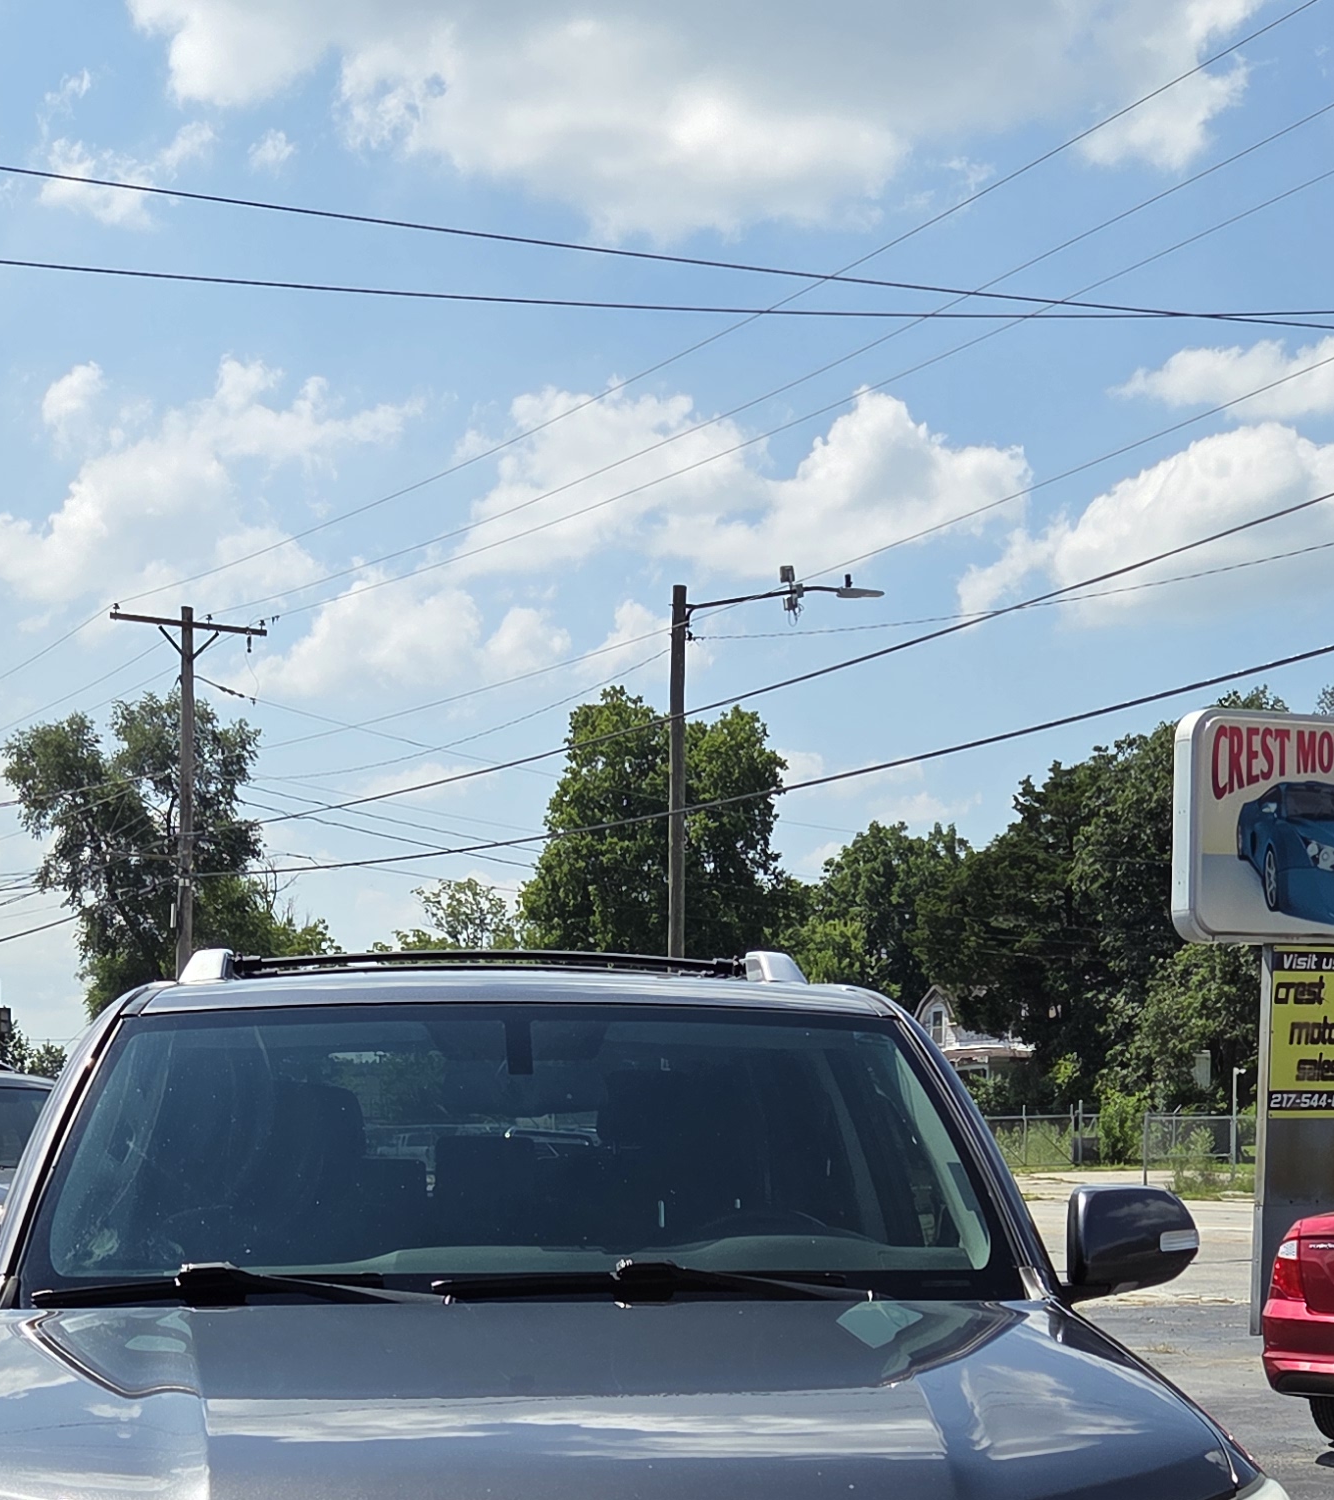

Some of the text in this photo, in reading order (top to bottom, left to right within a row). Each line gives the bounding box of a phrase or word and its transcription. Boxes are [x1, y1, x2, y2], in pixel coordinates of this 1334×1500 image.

[1211, 724, 1291, 801] CREST
[1283, 954, 1318, 970] Visit
[1274, 975, 1325, 1005] crest
